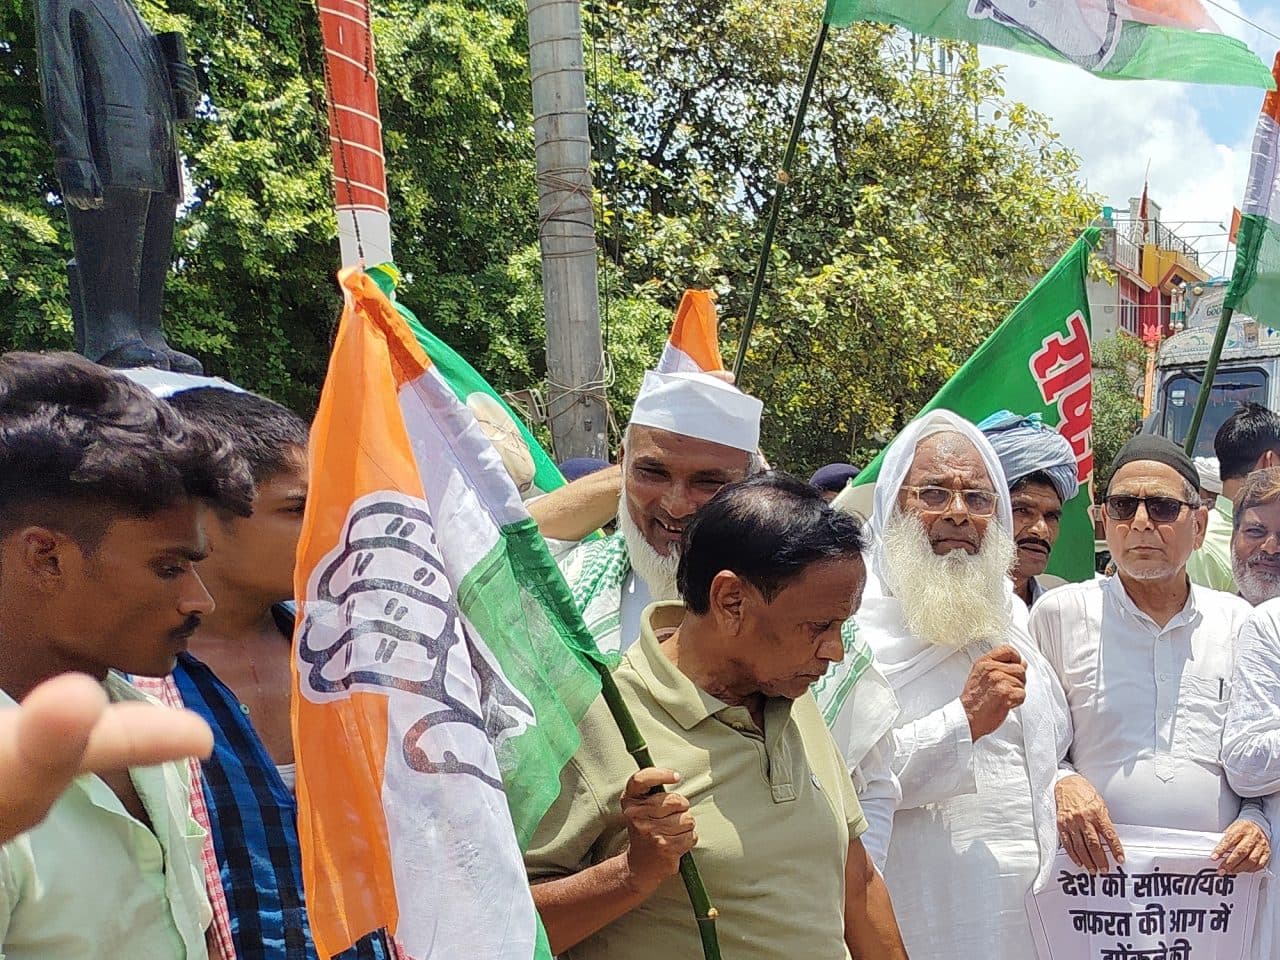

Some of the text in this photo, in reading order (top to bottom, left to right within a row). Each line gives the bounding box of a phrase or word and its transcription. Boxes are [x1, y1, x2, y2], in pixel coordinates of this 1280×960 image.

[1057, 866, 1237, 898] देश को सांप्रदायिक
[1069, 902, 1234, 937] नफरत की आग में
